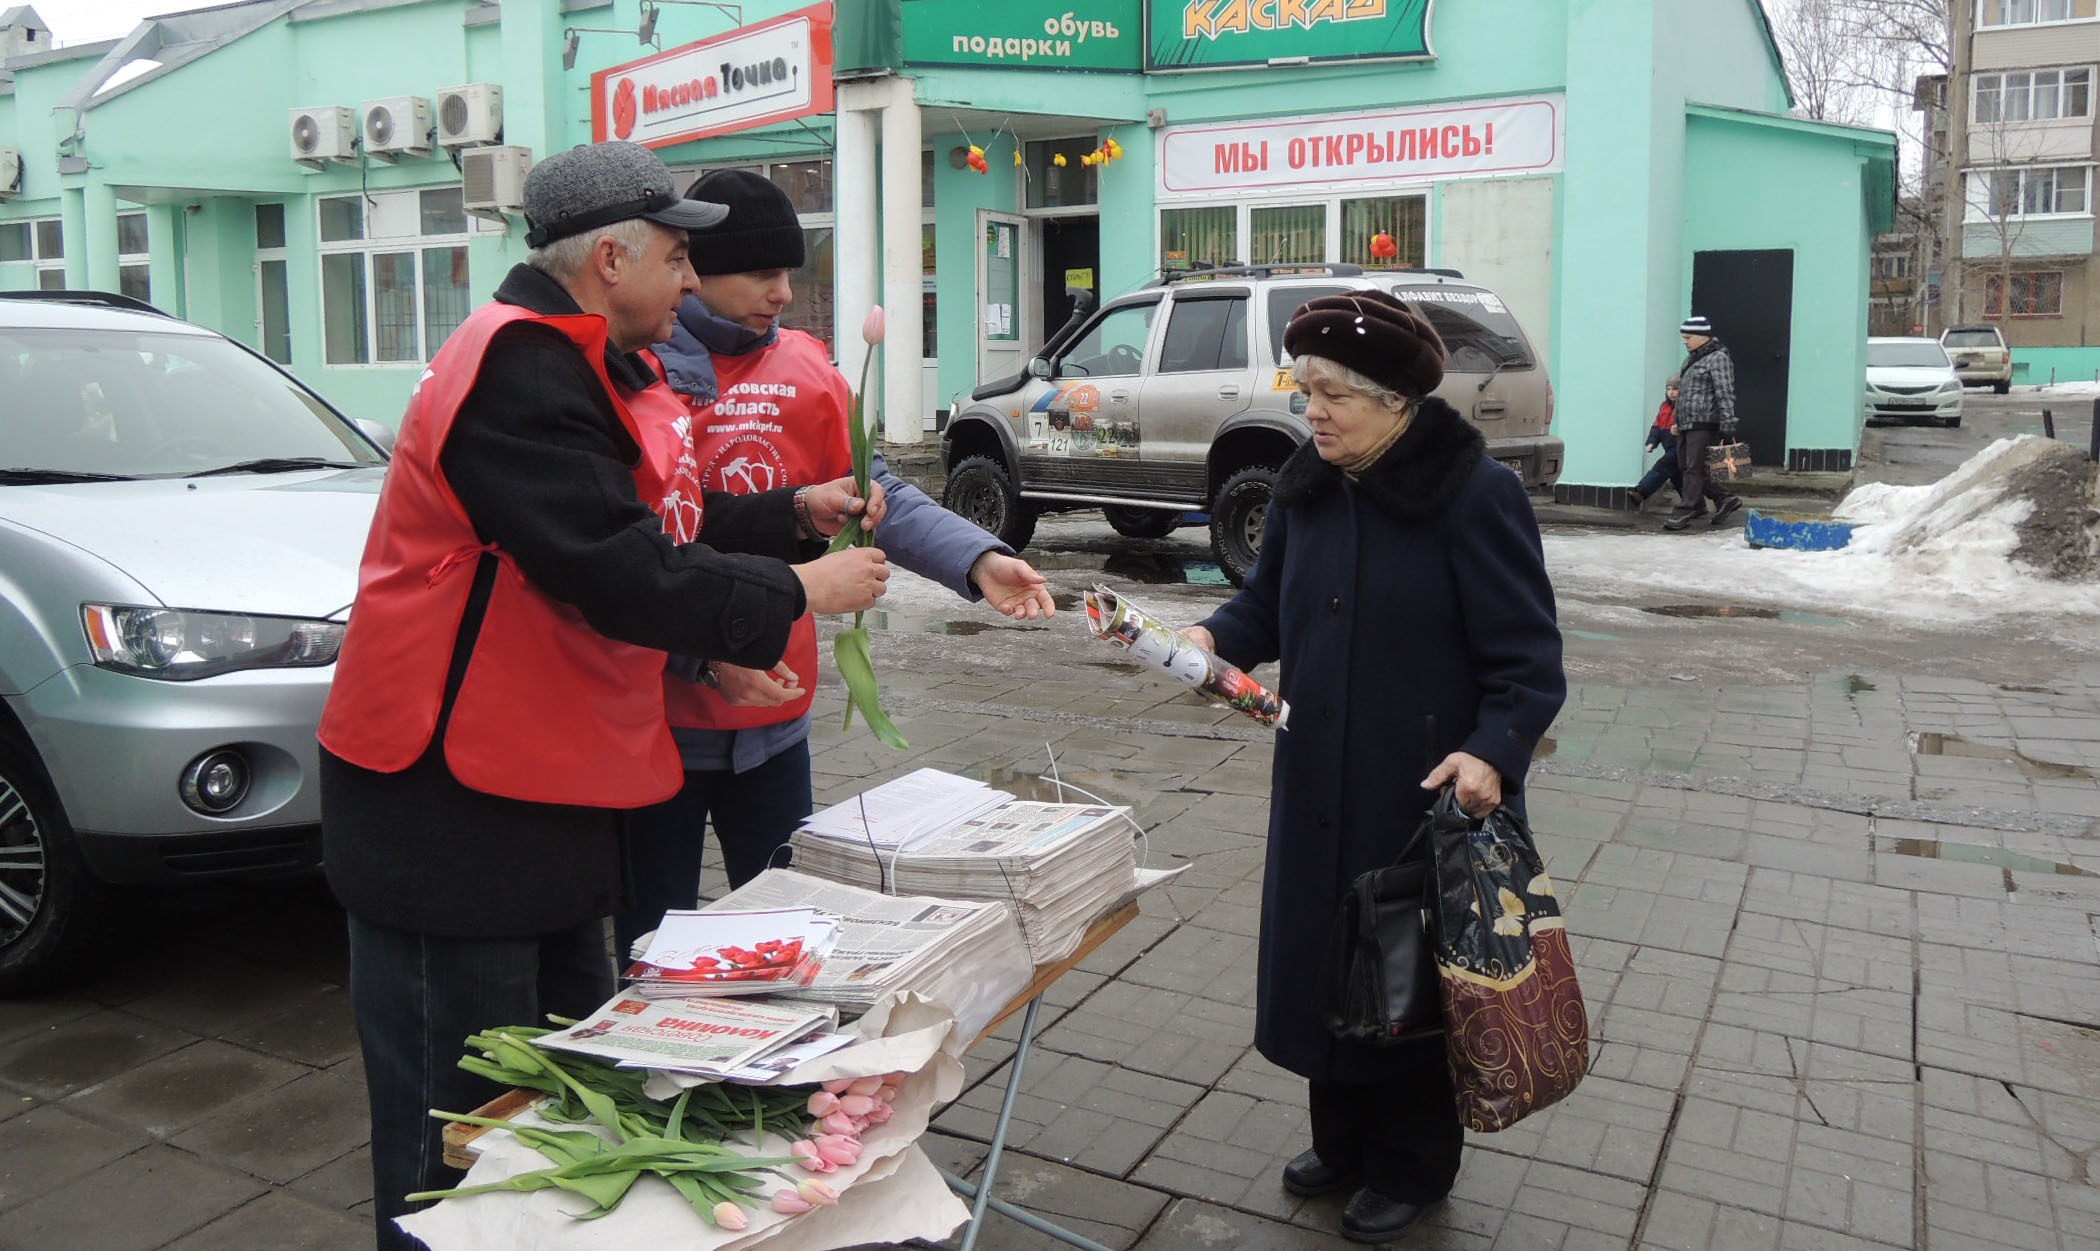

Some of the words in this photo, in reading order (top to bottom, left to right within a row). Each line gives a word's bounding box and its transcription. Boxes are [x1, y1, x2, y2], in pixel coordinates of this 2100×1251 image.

[1044, 11, 1120, 43] обувь
[953, 35, 1072, 61] подарки
[642, 75, 718, 115] Мясная
[720, 56, 787, 94] Точка
[1214, 140, 1268, 174] МЫ
[1287, 122, 1493, 170] ОТКРЫЛИСЬ!
[1395, 291, 1443, 302] АЛФАВИТ
[1080, 392, 1089, 402] 22
[714, 398, 781, 416] область
[1034, 421, 1042, 438] 7
[1097, 427, 1116, 444] 22
[1050, 437, 1069, 452] 121
[621, 1024, 713, 1043] Советская
